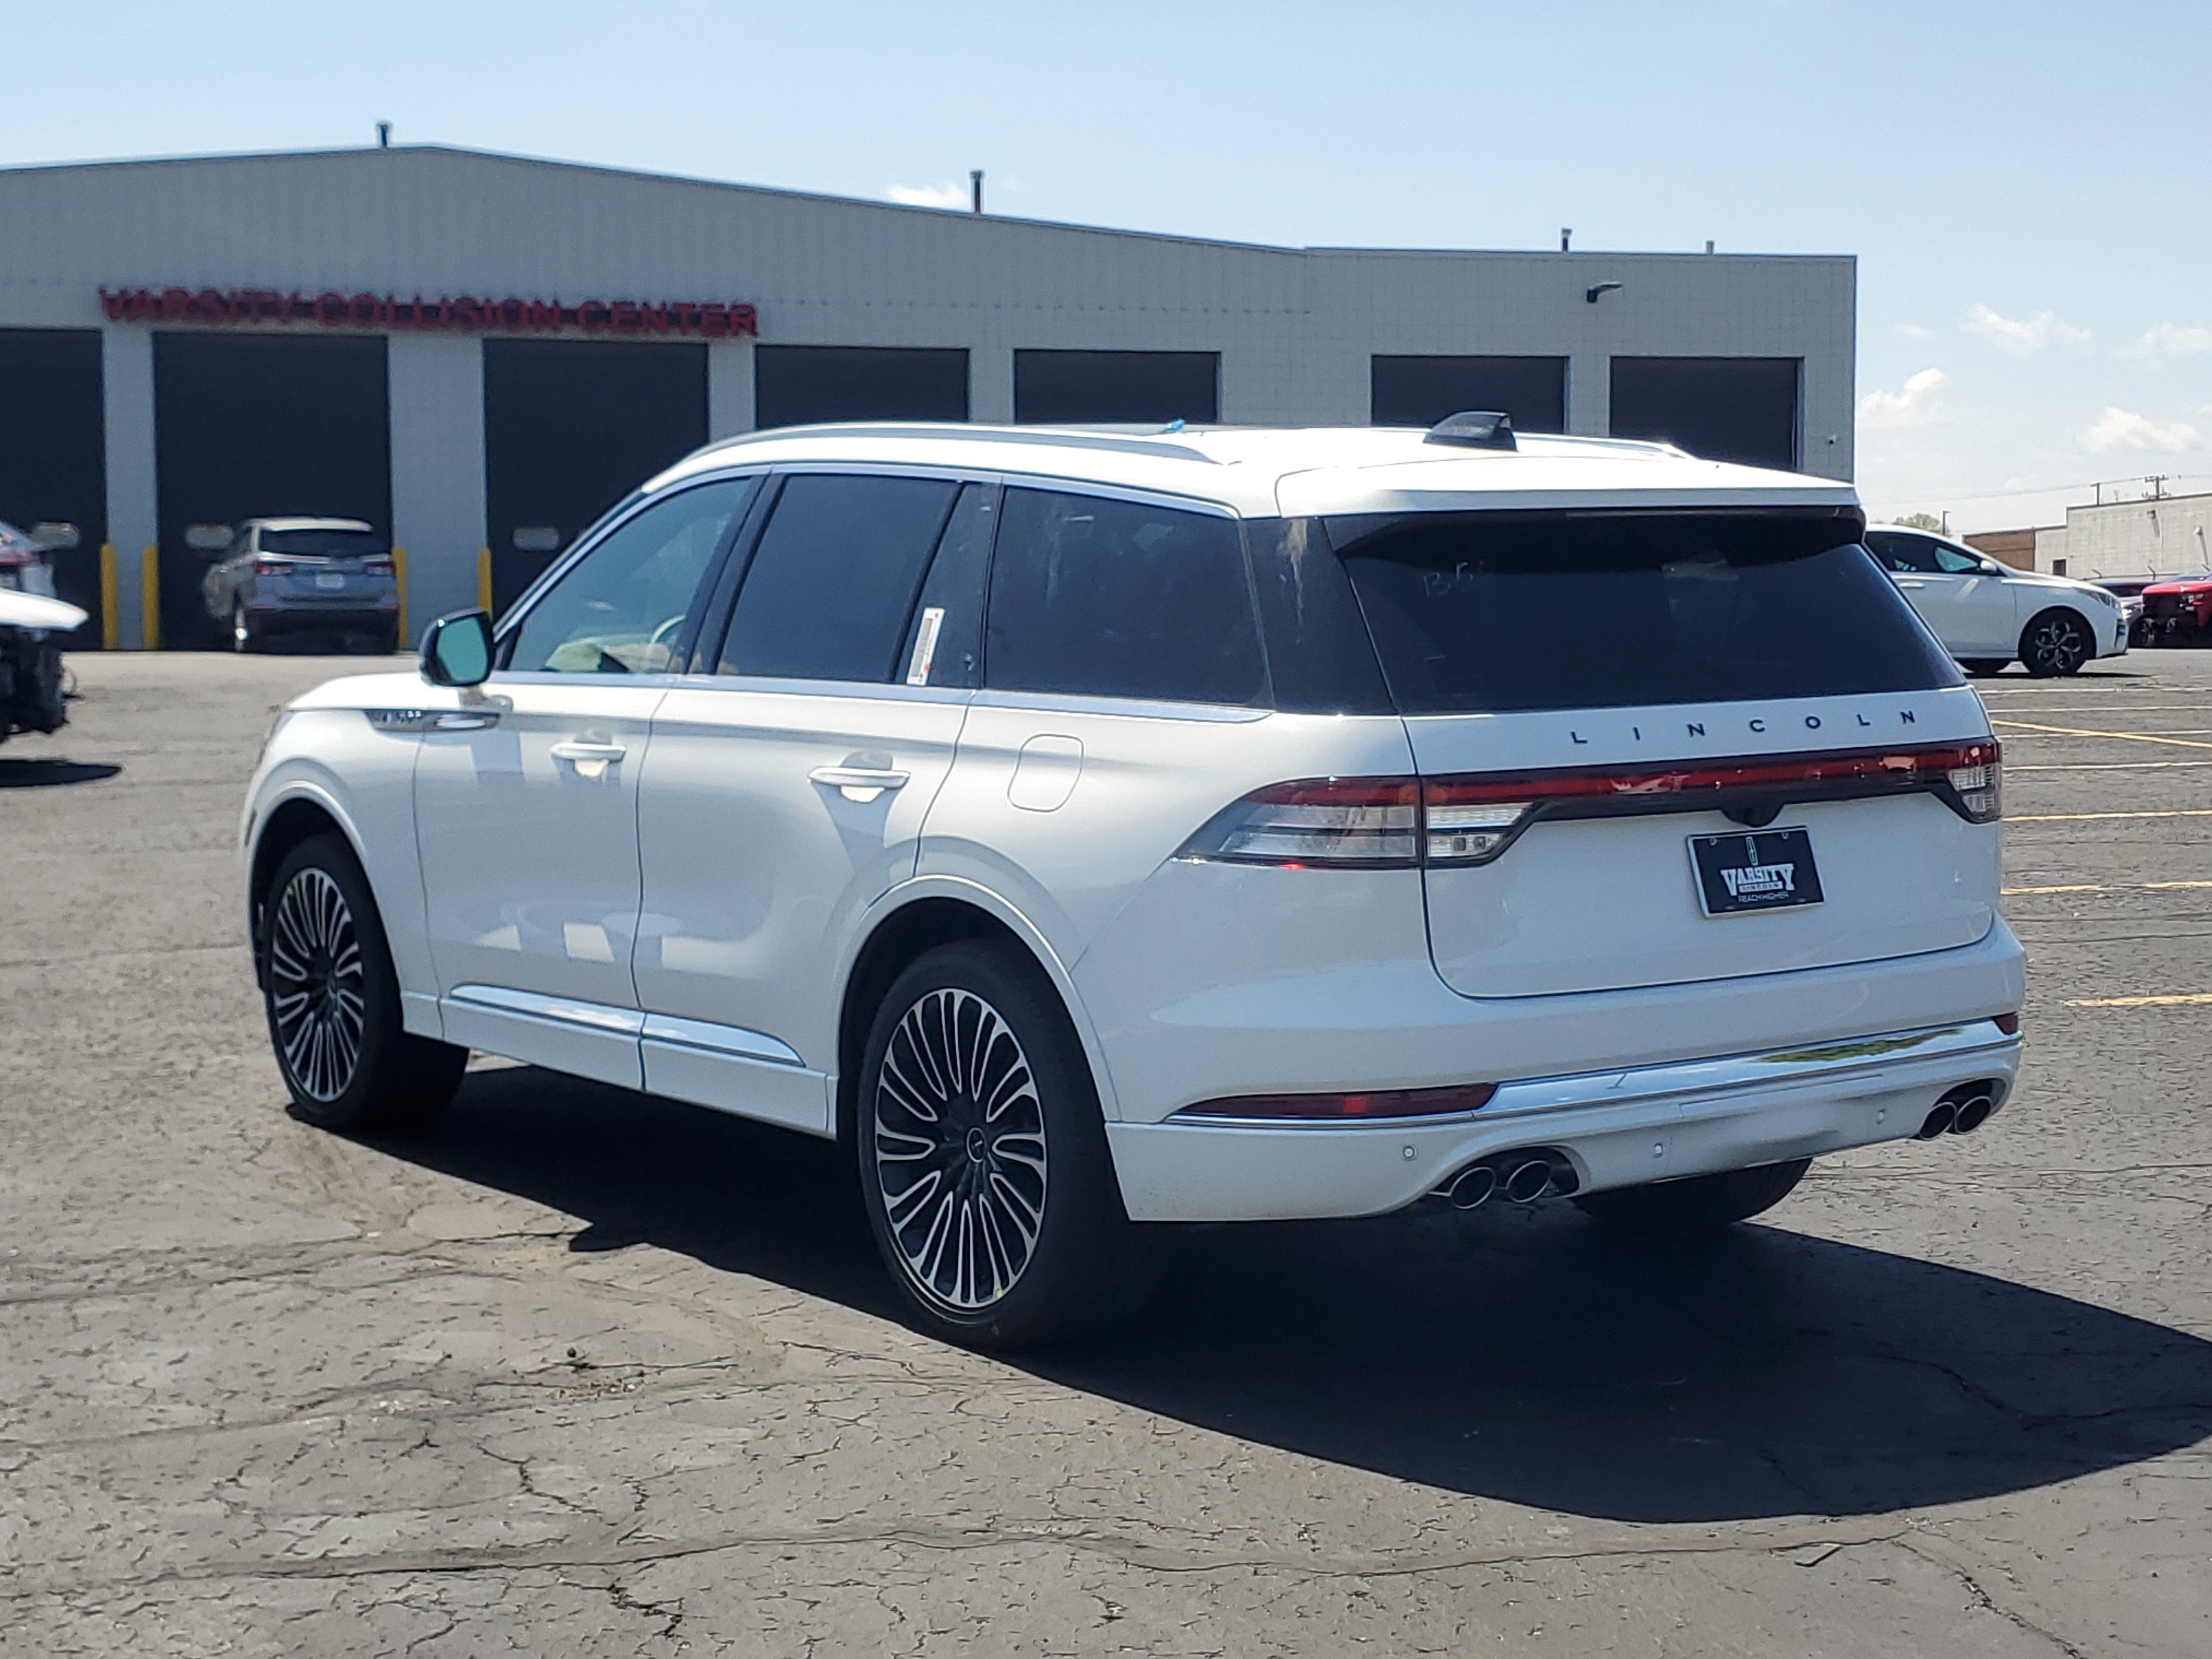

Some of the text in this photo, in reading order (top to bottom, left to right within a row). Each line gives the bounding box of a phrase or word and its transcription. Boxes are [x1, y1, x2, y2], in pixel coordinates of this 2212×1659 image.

[313, 292, 562, 332] COLLISION
[577, 300, 759, 337] CENTER
[1571, 711, 1915, 744] LINCOLN
[1720, 863, 1795, 896] VARSITY
